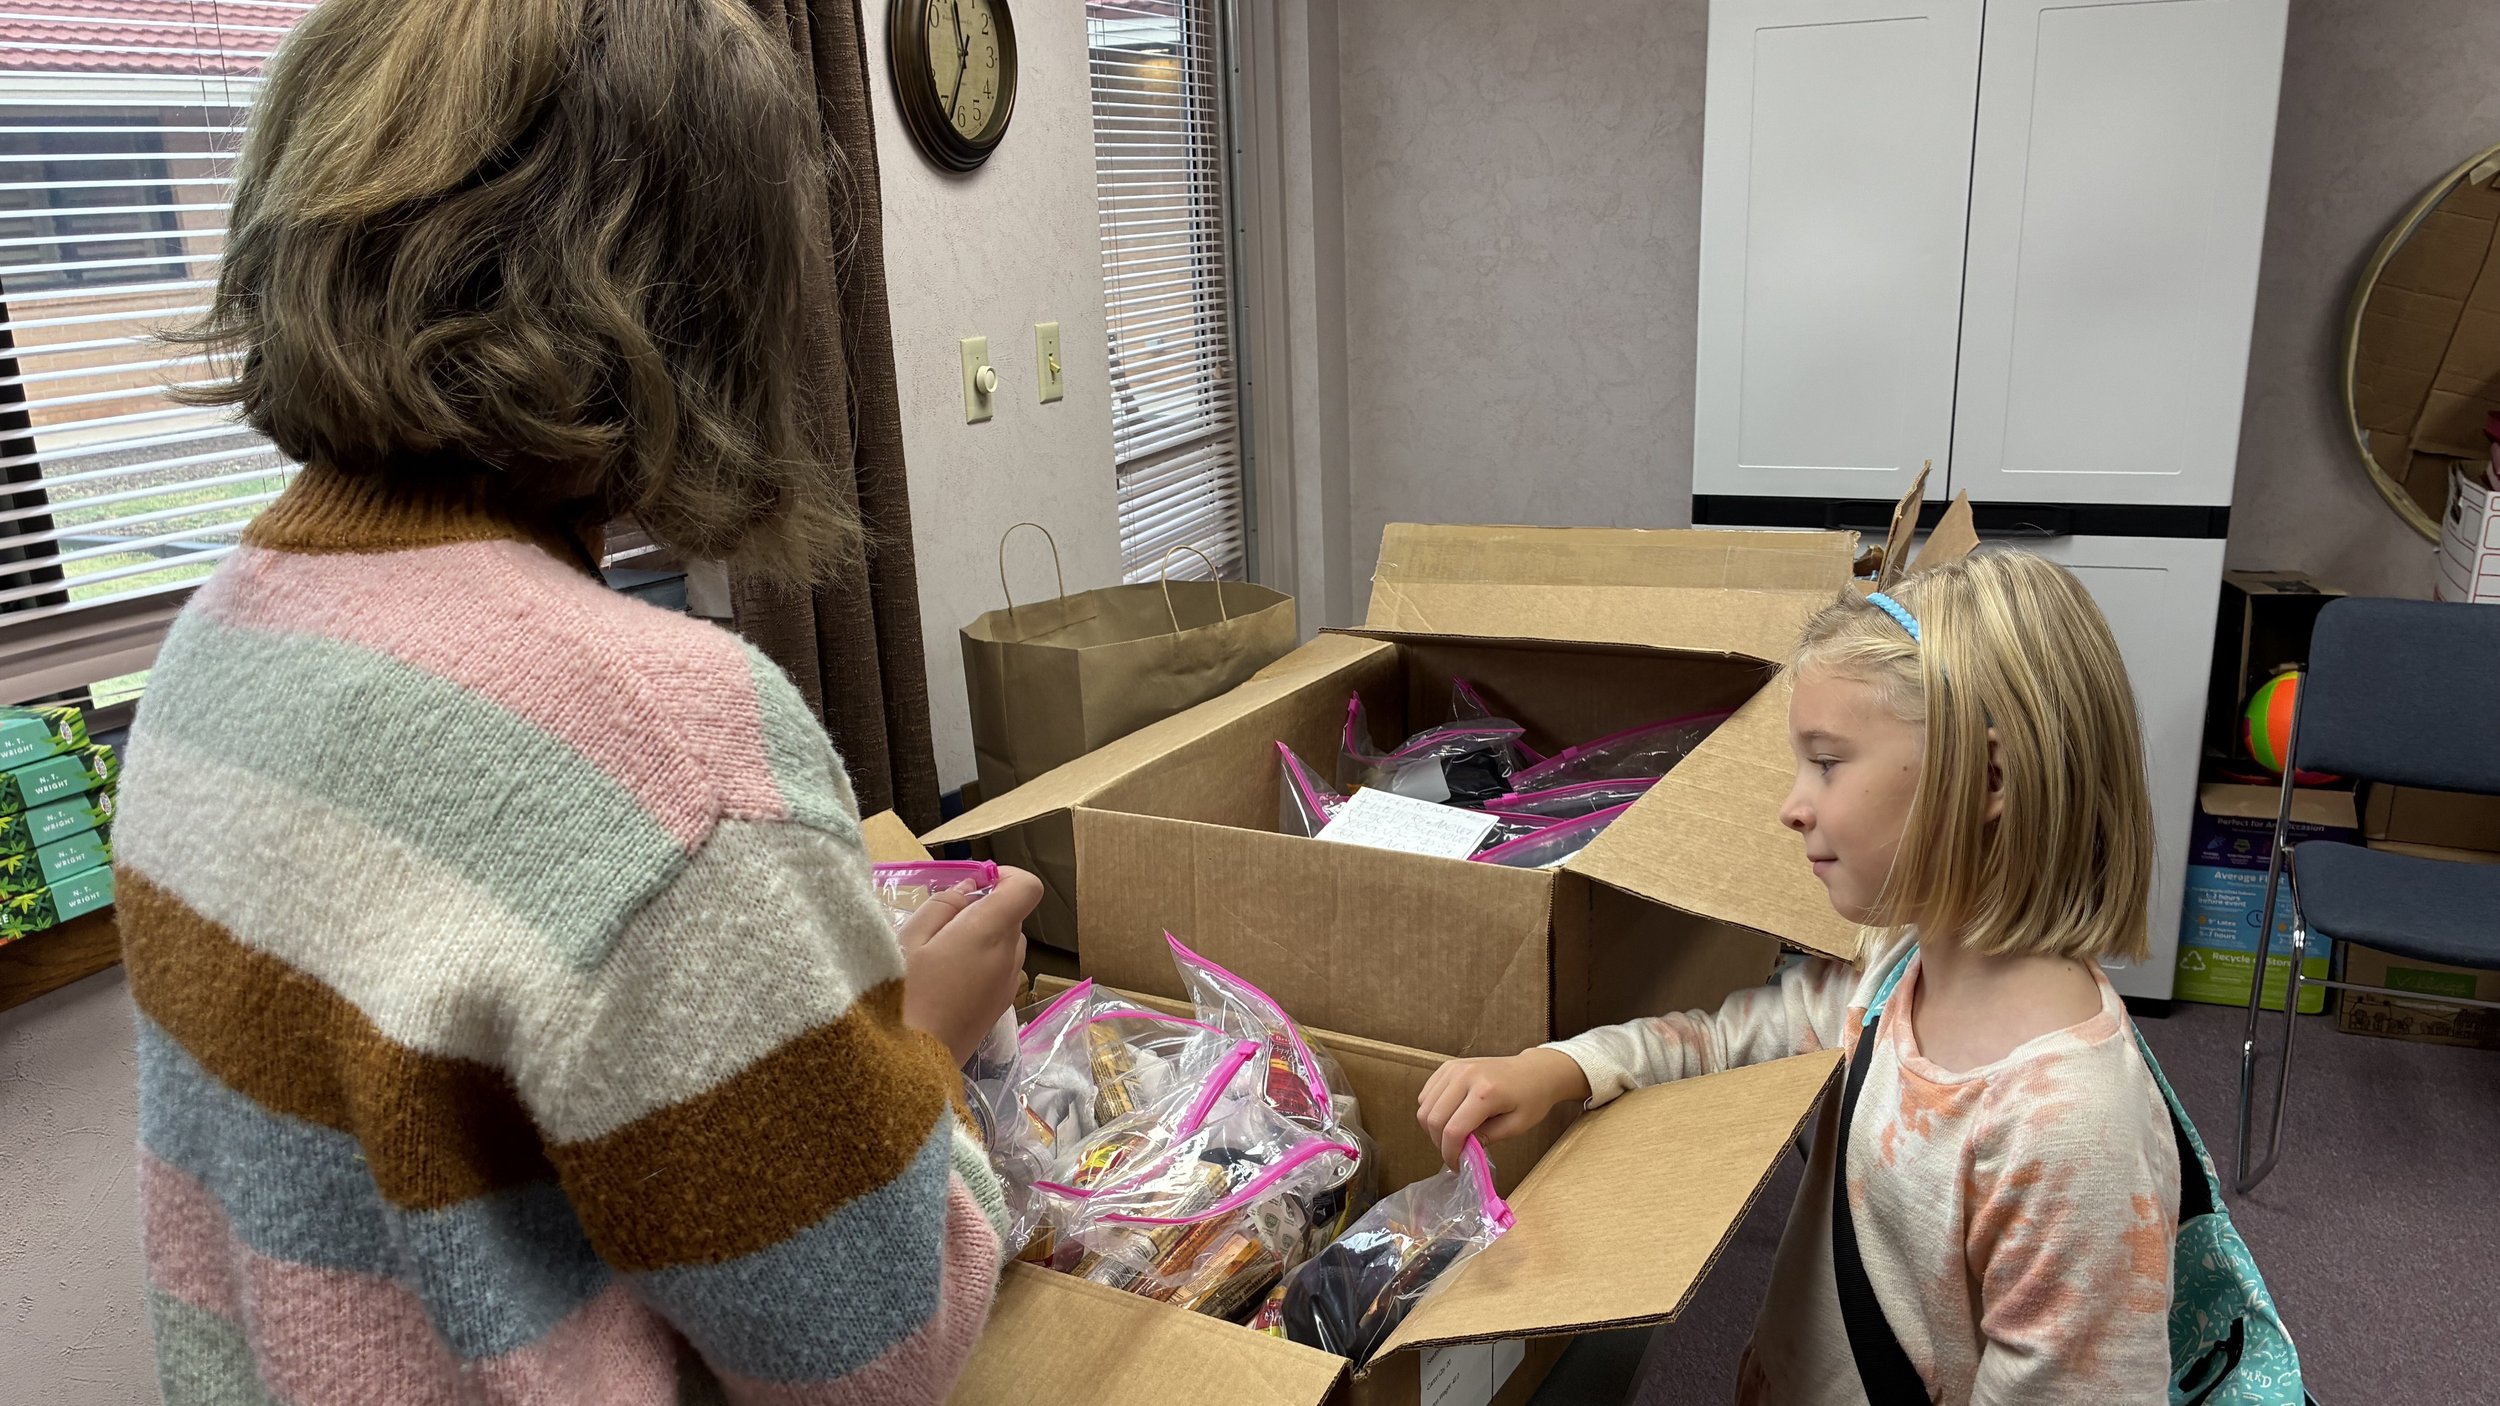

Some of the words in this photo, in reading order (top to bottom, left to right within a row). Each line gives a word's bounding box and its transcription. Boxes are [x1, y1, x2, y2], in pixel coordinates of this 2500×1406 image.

[981, 12, 989, 35] 2
[985, 46, 995, 69] 3
[983, 77, 992, 99] 4
[957, 105, 966, 128] 6
[972, 99, 982, 121] 5
[0, 743, 34, 759] WRIGHT
[4, 739, 15, 748] N.
[35, 779, 69, 795] WRIGHT
[38, 775, 49, 784] N.
[46, 812, 57, 821] N.
[57, 810, 66, 818] T.
[2217, 817, 2249, 828] Perfect
[2251, 819, 2264, 828] for
[42, 816, 75, 833] WRIGHT
[58, 849, 68, 858] N.
[70, 846, 78, 855] T.
[54, 852, 86, 869] WRIGHT
[2214, 870, 2256, 884] Average
[68, 890, 101, 908] WRIGHT
[72, 888, 83, 897] N.
[84, 885, 92, 894] T.
[2213, 932, 2237, 941] hours
[2212, 952, 2251, 965] Recycle
